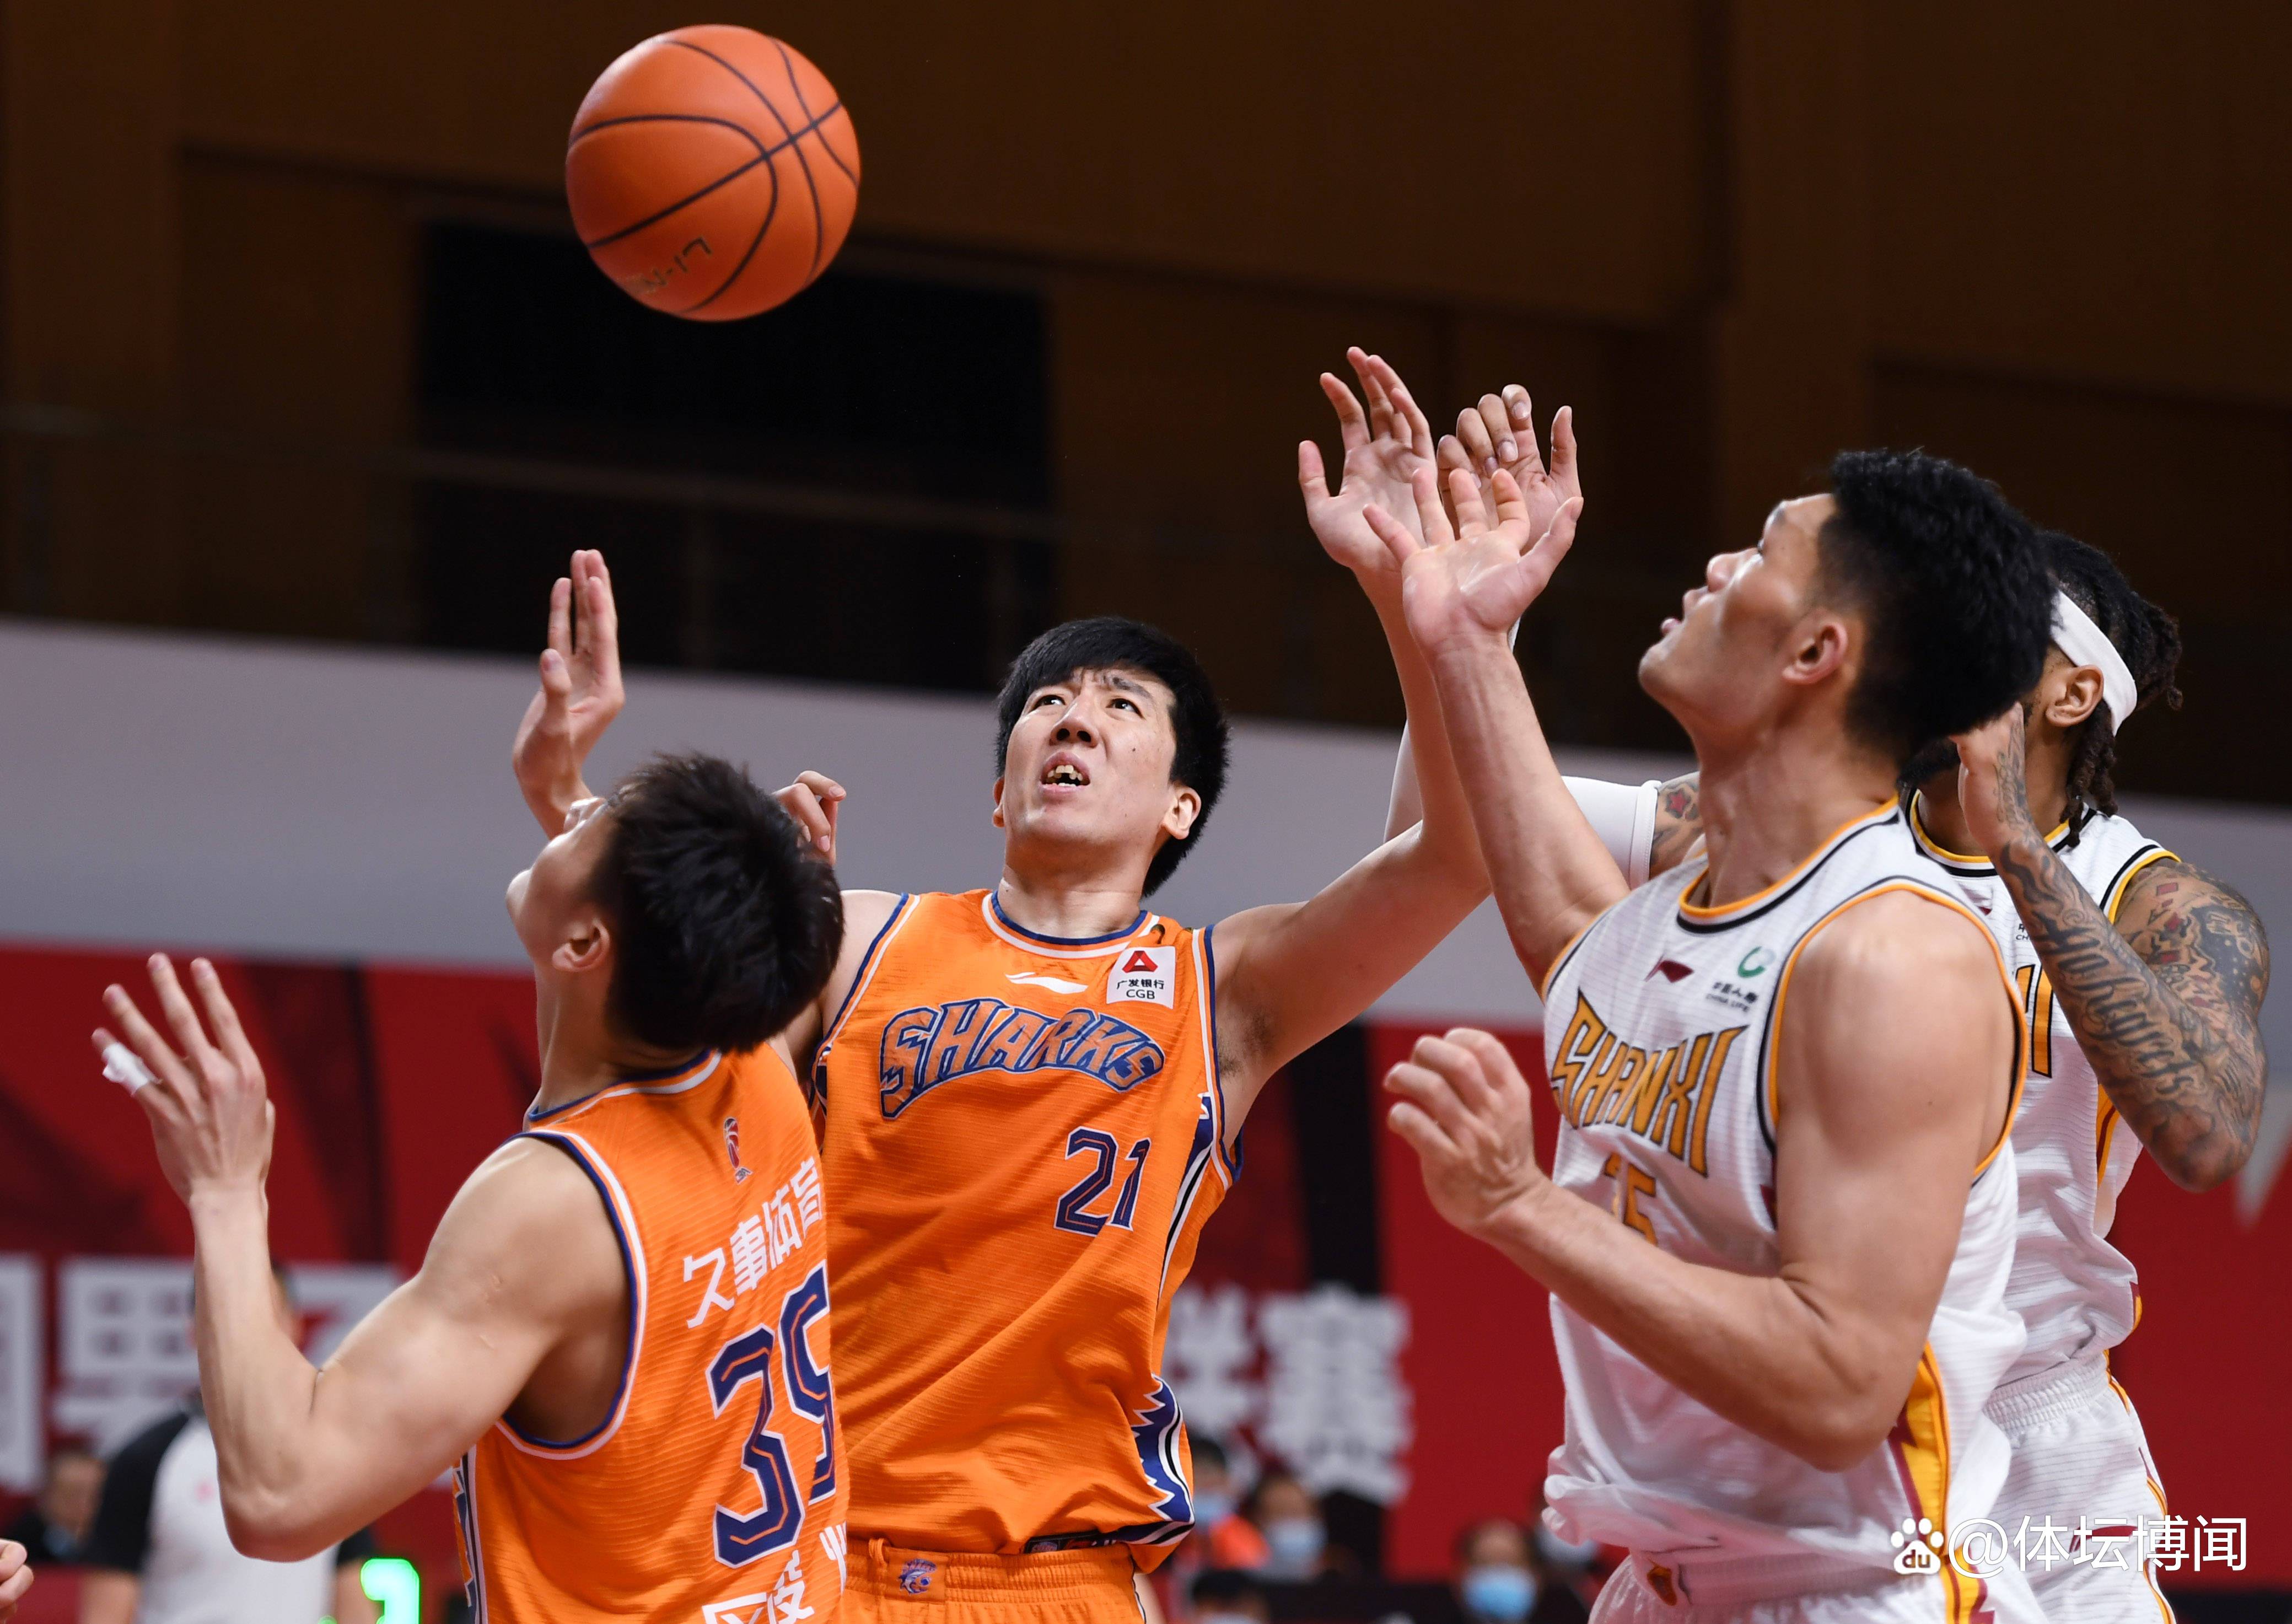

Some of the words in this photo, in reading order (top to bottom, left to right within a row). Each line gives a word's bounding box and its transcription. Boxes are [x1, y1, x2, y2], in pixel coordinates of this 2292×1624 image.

[1116, 978, 1164, 990] 广发银行
[1126, 989, 1155, 999] CGB
[879, 997, 1164, 1120] SHARKS
[1551, 986, 1749, 1178] SHANXI
[683, 1156, 822, 1329] 久事体育
[1053, 1126, 1152, 1237] 21
[705, 1259, 836, 1569] 39
